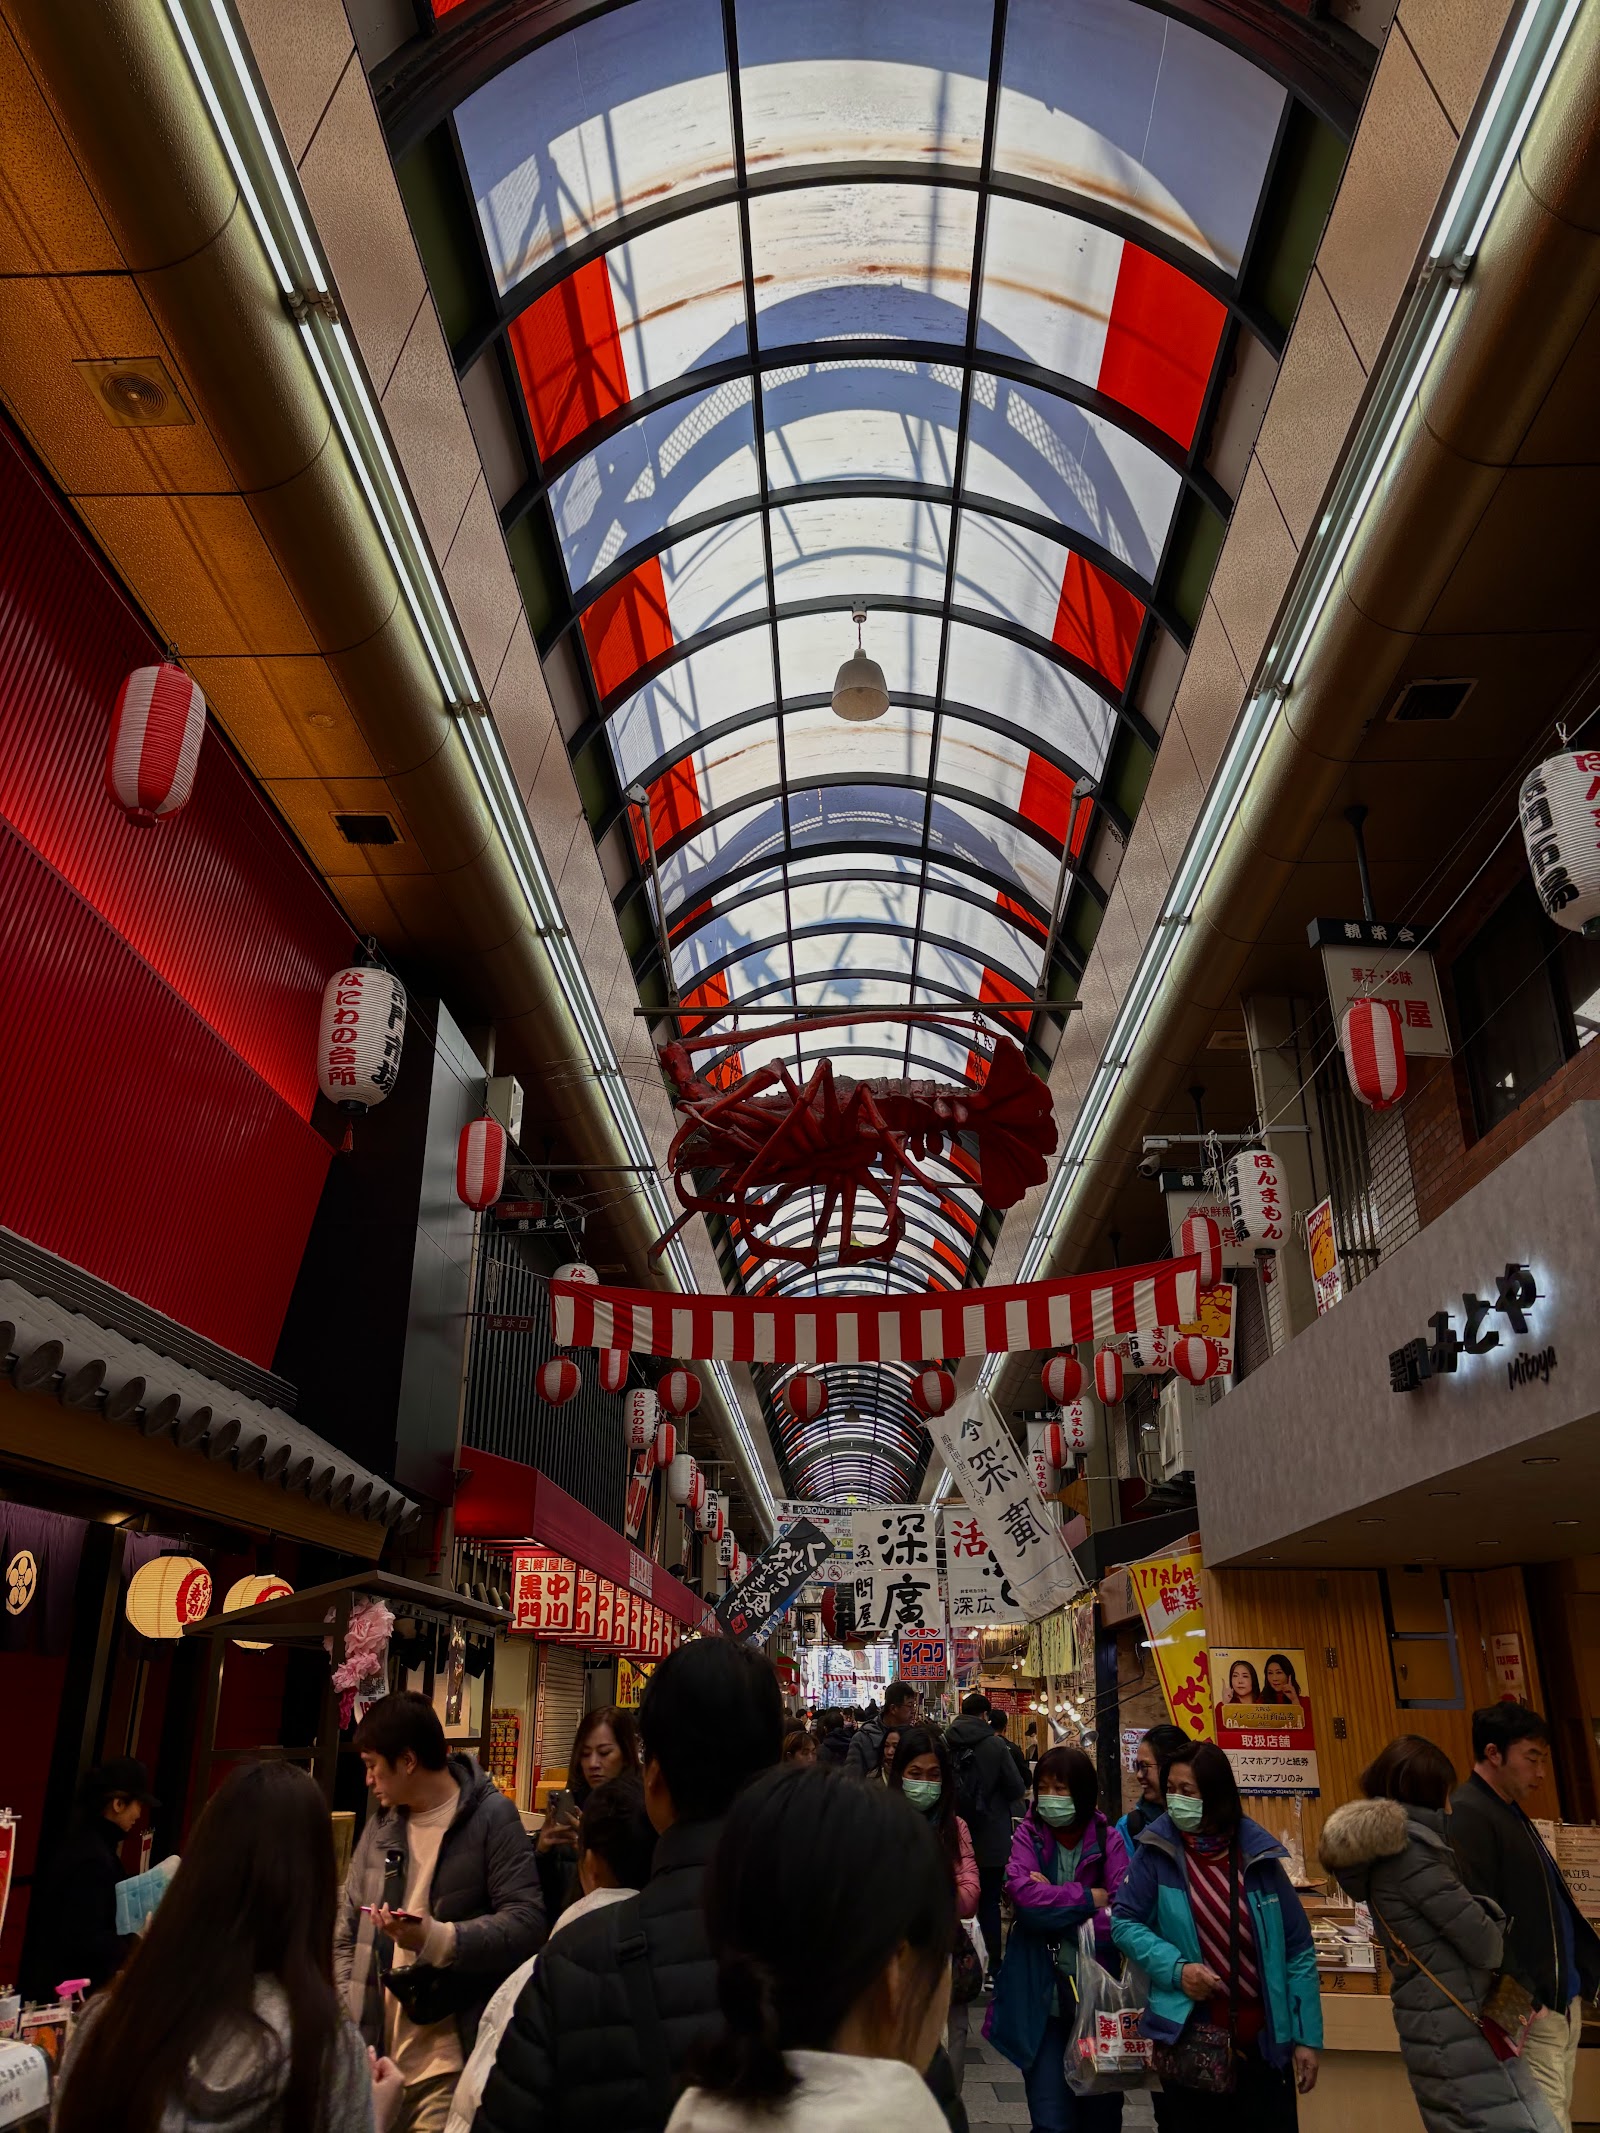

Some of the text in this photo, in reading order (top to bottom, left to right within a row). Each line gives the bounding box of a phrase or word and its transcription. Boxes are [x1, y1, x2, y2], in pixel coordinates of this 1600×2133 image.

[327, 972, 364, 1086] なにわの台所
[1254, 1154, 1283, 1240] ほんまもん
[492, 1317, 529, 1329] 送水口
[1428, 1263, 1537, 1373] みとや
[1507, 1345, 1557, 1391] Mitoya
[631, 1391, 645, 1444] なにわの台所
[706, 1493, 718, 1529] 黒門市場
[797, 1506, 836, 1516] KUROMON
[720, 1531, 732, 1562] 黒門市場
[950, 1517, 989, 1558] 活
[517, 1559, 576, 1571] 生鮮屋台
[877, 1513, 931, 1630] 深廣
[1140, 1563, 1194, 1589] 11月6日
[516, 1573, 542, 1628] 黒門
[545, 1573, 571, 1628] 中川
[854, 1544, 876, 1629] 魚問屋
[1159, 1582, 1204, 1617] 解禁
[953, 1595, 996, 1616] 深広
[903, 1642, 944, 1663] ダイコク
[1241, 1734, 1291, 1748] 取扱店舗
[1240, 1756, 1309, 1767] スマホアプリと紙券
[1242, 1773, 1304, 1783] スマホアプリのみ
